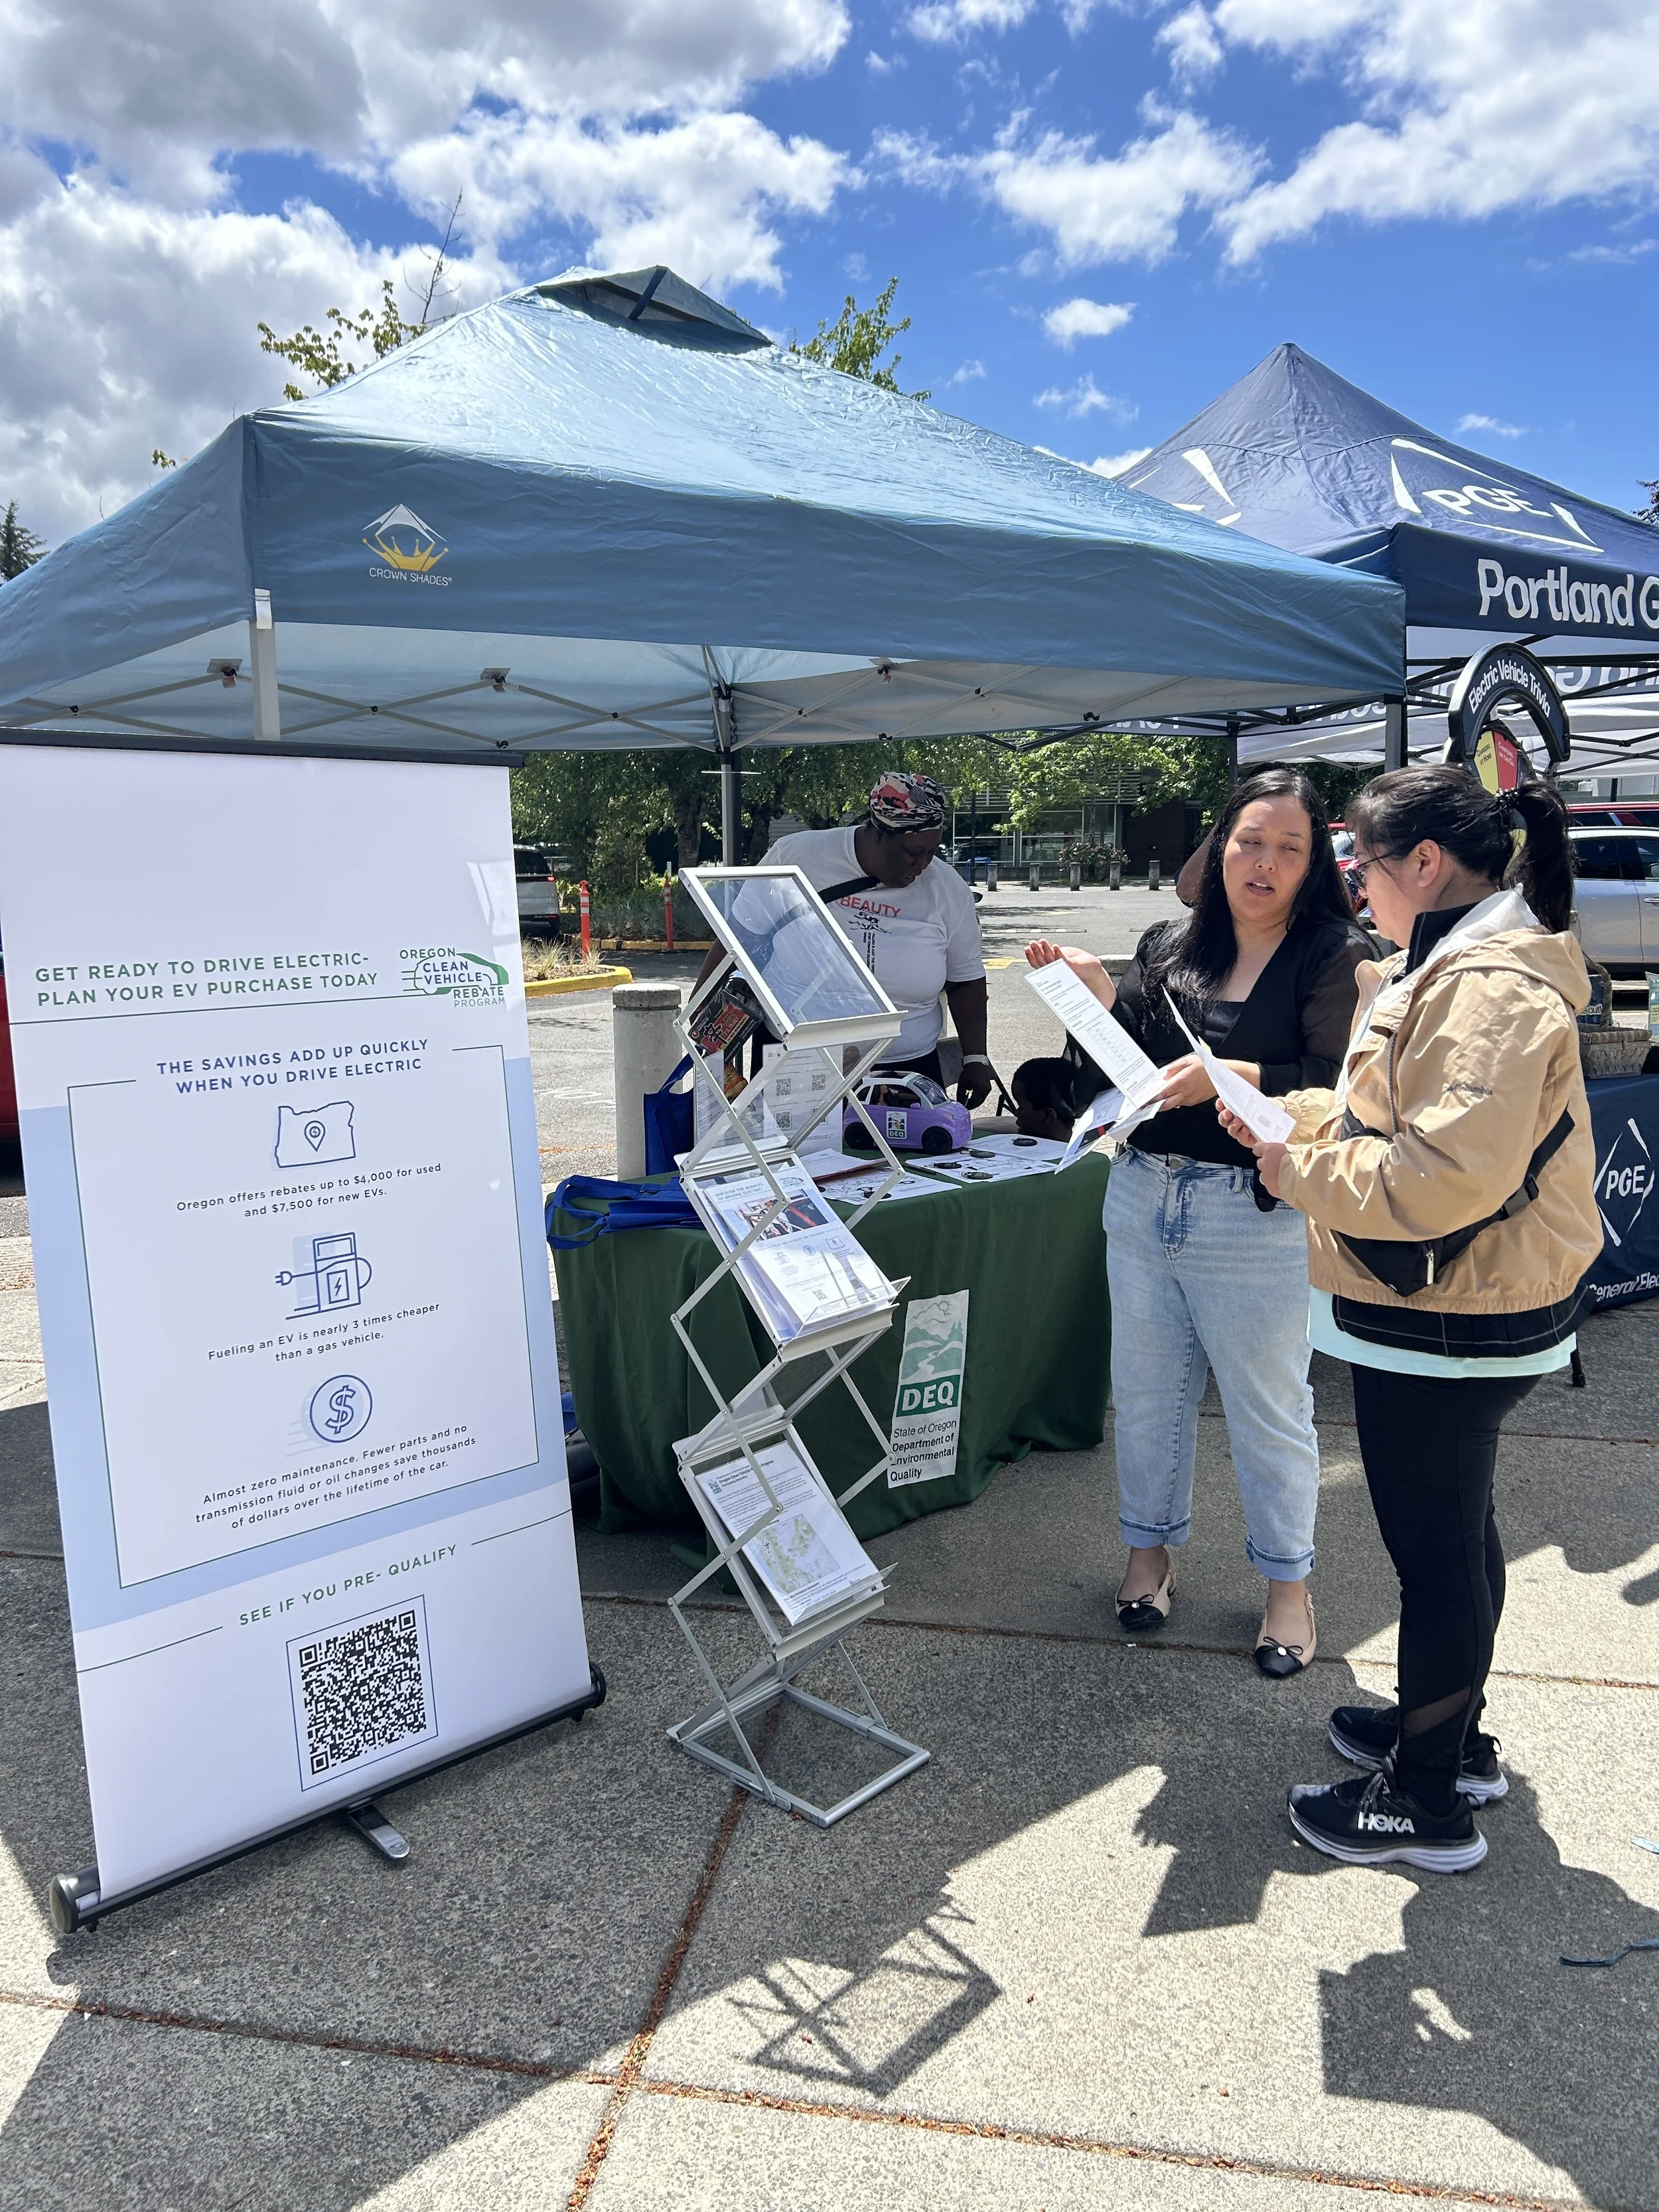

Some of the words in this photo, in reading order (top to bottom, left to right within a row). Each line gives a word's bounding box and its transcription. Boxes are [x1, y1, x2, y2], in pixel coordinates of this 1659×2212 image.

[1422, 484, 1553, 518] PGE
[369, 567, 407, 581] CROWN
[1478, 558, 1634, 627] Portland
[1469, 665, 1499, 714] Electric
[1497, 659, 1529, 688] Vehicle
[1529, 672, 1551, 718] Trivia
[840, 895, 901, 918] BEAUTY
[36, 967, 78, 982] GET
[89, 962, 159, 979] READY
[167, 961, 194, 974] TO
[204, 958, 265, 972] DRIVE
[273, 953, 368, 969] ELECTRIC-
[400, 948, 455, 959] OREGON
[423, 961, 468, 972] CLEAN
[38, 990, 96, 1006] PLAN
[105, 986, 163, 1001] YOUR
[173, 984, 198, 997] EV
[208, 977, 313, 995] PURCHASE
[319, 973, 377, 988] TODAY
[424, 972, 482, 985] VEHICLE
[453, 987, 504, 998] REBATE
[454, 997, 505, 1007] PROGRAM
[157, 1061, 193, 1074] THE
[202, 1053, 281, 1070] SAVINGS
[289, 1049, 325, 1063] ADD
[333, 1046, 353, 1058] UP
[360, 1039, 427, 1055] QUICKLY
[176, 1077, 232, 1093] WHEN
[240, 1073, 277, 1086] YOU
[286, 1067, 338, 1082] DRIVE
[345, 1059, 421, 1076] ELECTRIC
[177, 1198, 224, 1211] Oregon
[229, 1192, 265, 1203] offers
[271, 1185, 315, 1197] rebates
[354, 1171, 392, 1185] $4,000
[417, 1163, 441, 1174] used
[1605, 1165, 1645, 1199] PGE
[245, 1206, 266, 1217] and
[271, 1199, 313, 1213] $7,500
[317, 1197, 334, 1205] for
[338, 1193, 360, 1202] new
[364, 1188, 386, 1198] EVs.
[209, 1345, 254, 1360] Fueling
[279, 1334, 293, 1345] EV
[299, 1332, 308, 1341] is
[313, 1324, 348, 1338] nearly
[352, 1320, 358, 1329] 3
[363, 1315, 392, 1326] times
[397, 1304, 439, 1319] cheaper
[275, 1351, 302, 1361] than
[317, 1343, 337, 1354] gas
[340, 1332, 384, 1346] vehicle.
[902, 1380, 954, 1412] DEQ
[892, 1436, 943, 1453] Department
[945, 1432, 954, 1442] of
[893, 1426, 916, 1438] State
[917, 1425, 926, 1434] of
[928, 1420, 957, 1434] Oregon
[204, 1485, 246, 1504] Almost
[251, 1478, 277, 1491] zero
[282, 1457, 358, 1482] maintenance.
[363, 1445, 396, 1459] Fewer
[400, 1436, 427, 1451] parts
[431, 1428, 450, 1440] and
[890, 1447, 954, 1466] nvironmental
[196, 1495, 273, 1522] transmission
[277, 1483, 304, 1499] fluid
[309, 1481, 321, 1490] or
[326, 1473, 340, 1485] oil
[344, 1462, 390, 1479] changes
[394, 1454, 417, 1465] save
[421, 1438, 475, 1458] thousands
[891, 1467, 922, 1482] Quality
[232, 1517, 244, 1528] of
[249, 1507, 289, 1523] dollars
[295, 1497, 319, 1510] over
[324, 1491, 342, 1501] the
[346, 1477, 389, 1495] lifetime
[394, 1471, 404, 1481] of
[408, 1467, 425, 1477] the
[430, 1461, 448, 1471] car.
[240, 1605, 271, 1625] SEE
[279, 1597, 294, 1613] IF
[302, 1584, 336, 1603] YOU
[344, 1572, 381, 1591] PRE-
[389, 1544, 456, 1575] QUALIFY
[1357, 1812, 1415, 1834] HOKA
